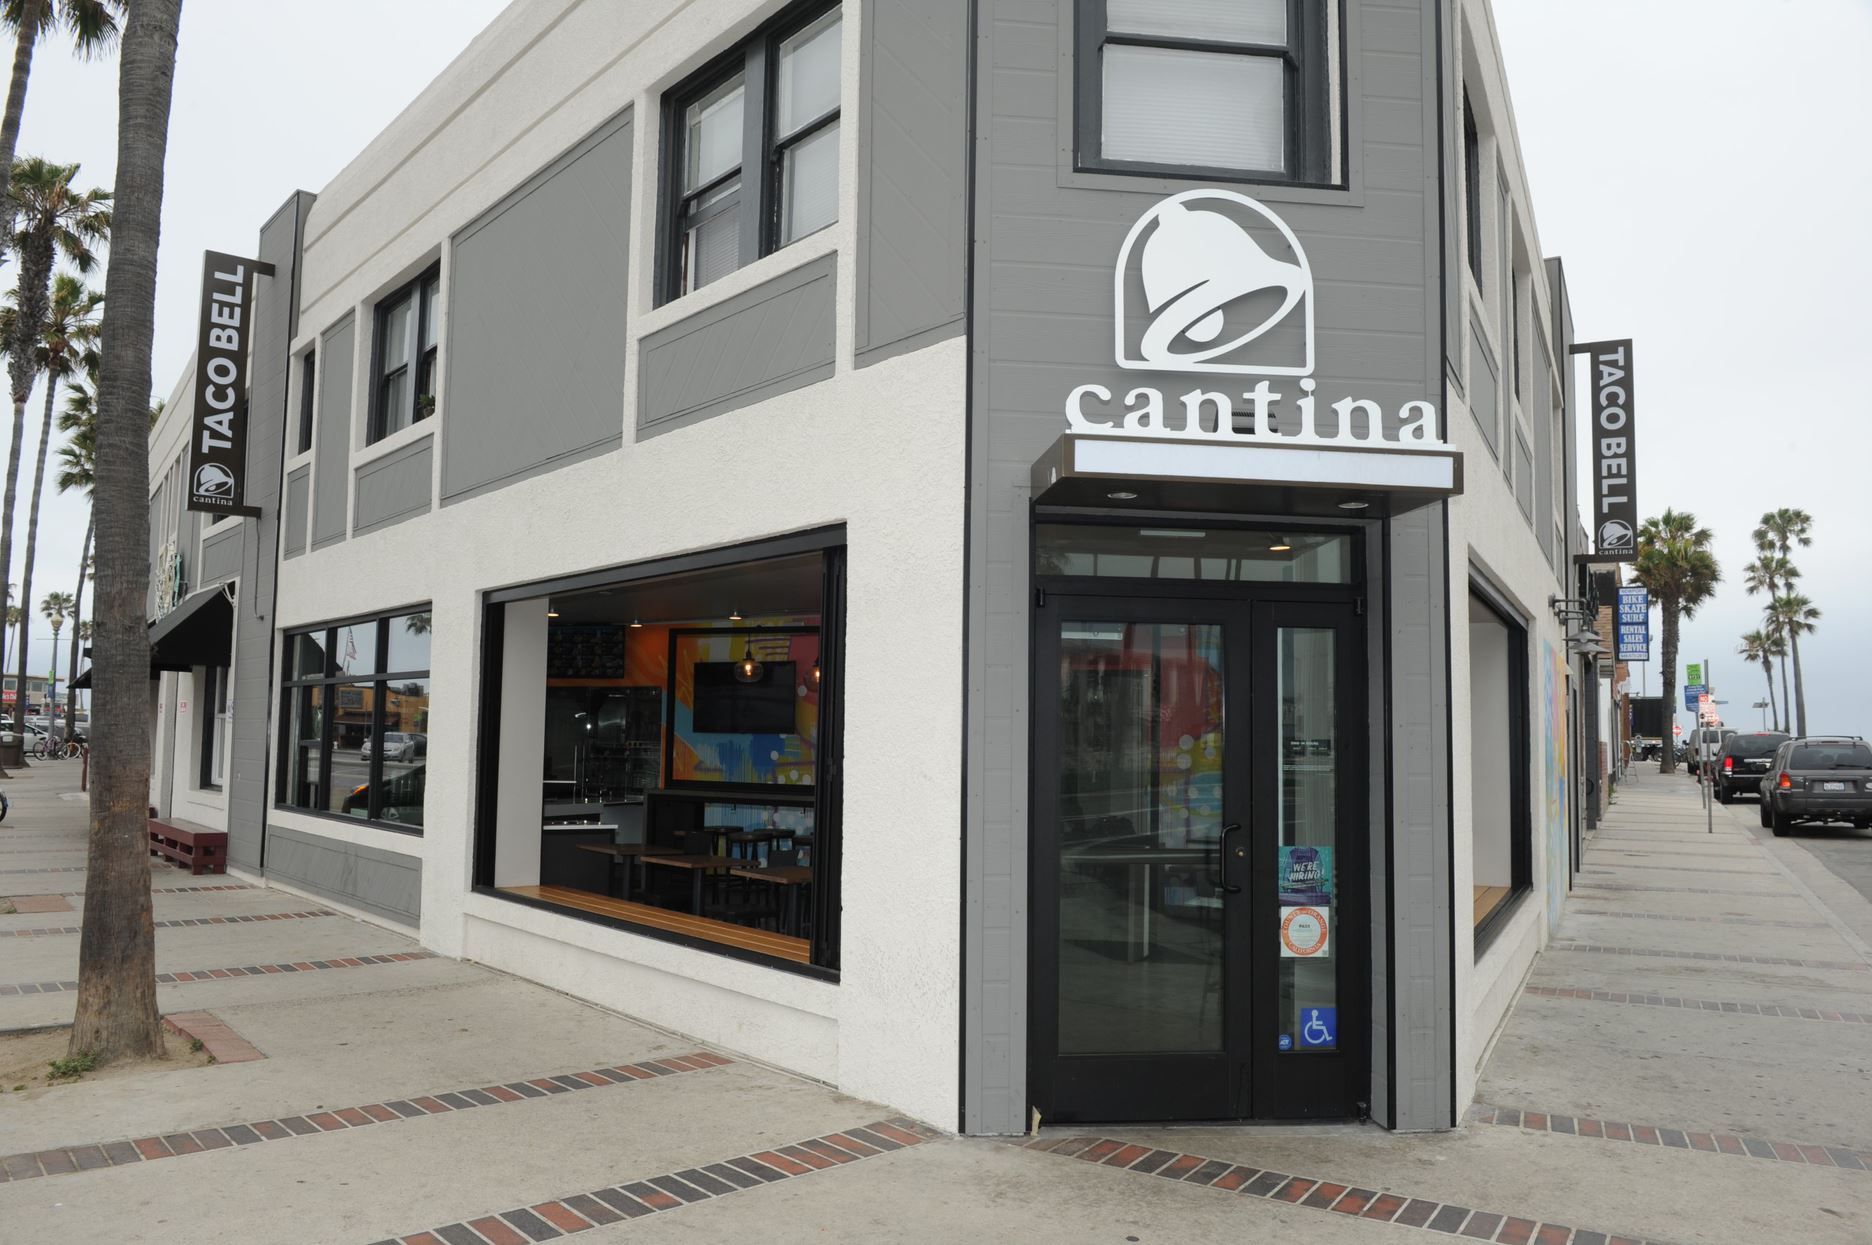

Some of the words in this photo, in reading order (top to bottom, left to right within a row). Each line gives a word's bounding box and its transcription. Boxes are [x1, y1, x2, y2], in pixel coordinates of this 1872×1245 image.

[209, 265, 244, 351] BELL
[1599, 346, 1626, 430] TACO
[202, 357, 237, 453] TACO
[1065, 378, 1445, 444] cantina
[1601, 437, 1628, 513] BELL
[193, 496, 233, 506] cantina
[1622, 595, 1644, 604] BIKE
[1619, 604, 1647, 613] SKATE
[1622, 613, 1645, 623] SURF
[1620, 625, 1646, 634] RENTAL
[1623, 634, 1644, 643] SALES
[1619, 643, 1647, 652] SERVICE
